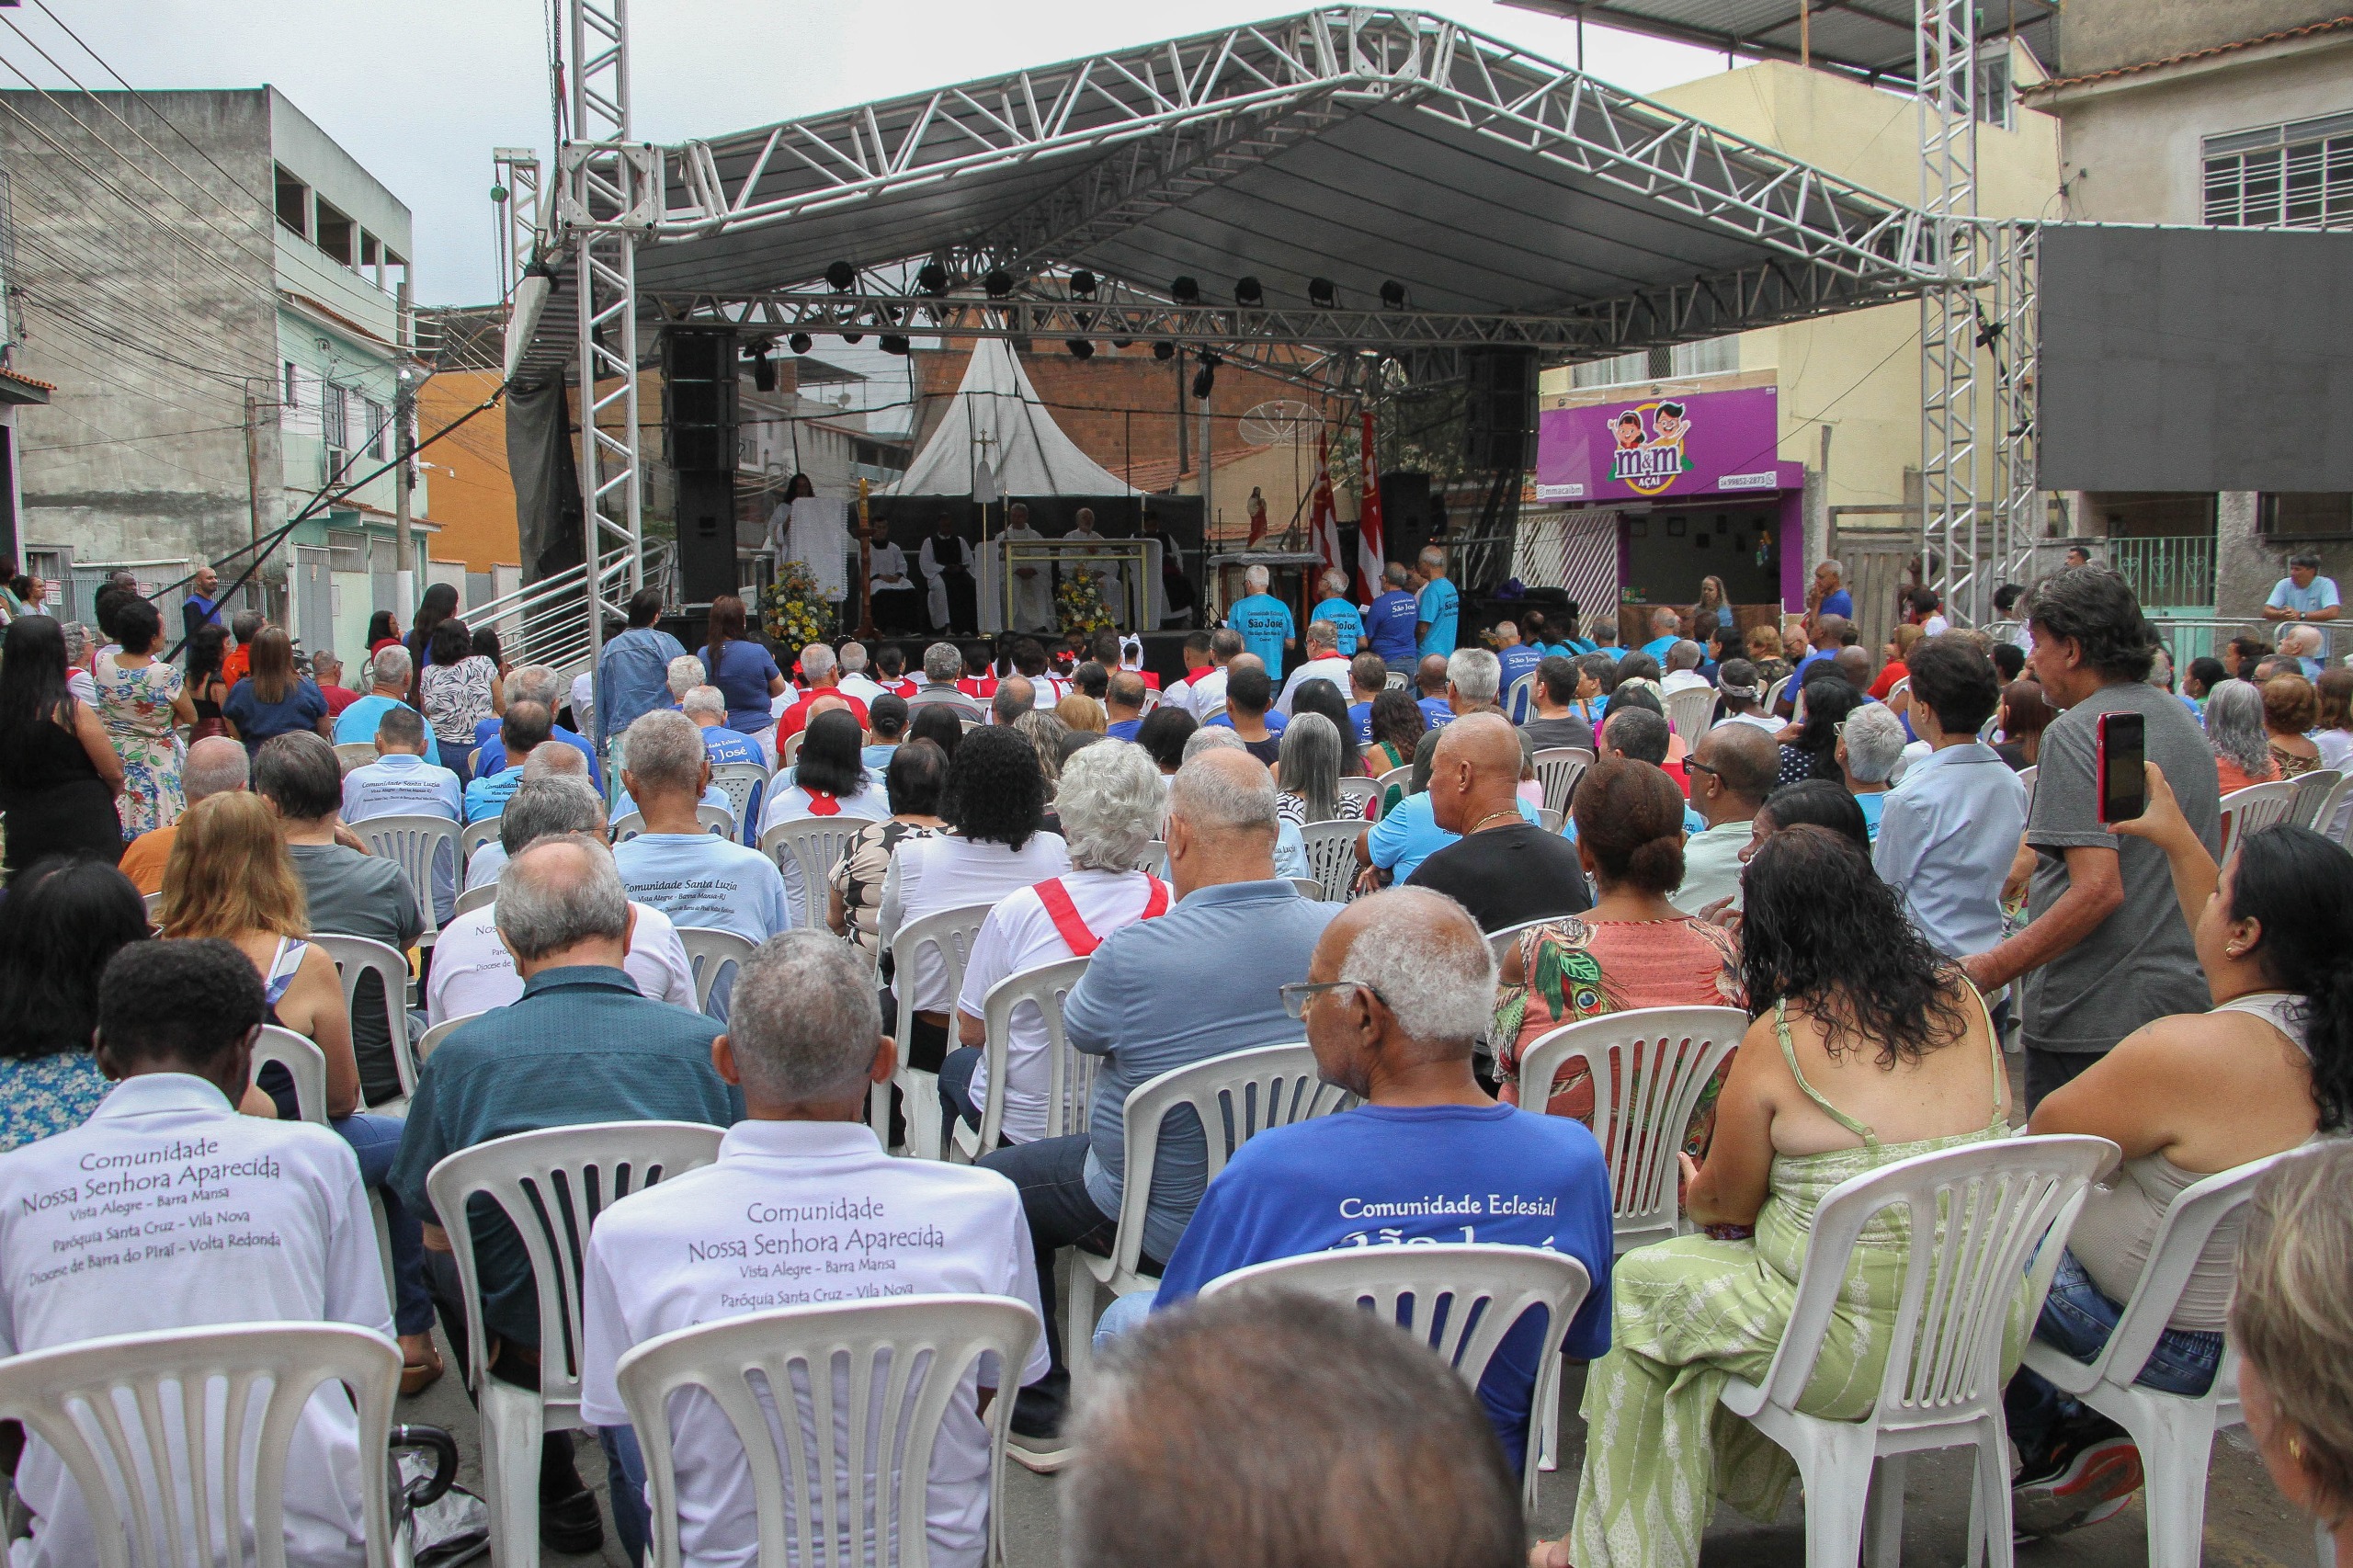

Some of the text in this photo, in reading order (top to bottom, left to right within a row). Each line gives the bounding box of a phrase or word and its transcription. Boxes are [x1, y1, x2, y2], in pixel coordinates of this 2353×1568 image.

[1638, 475, 1661, 488] AÇAÍ
[1247, 619, 1283, 628] São José
[718, 746, 748, 762] José
[624, 880, 738, 893] Comunidade Santa Luzia
[654, 894, 674, 903] Alegre
[475, 925, 497, 936] Nos
[476, 961, 501, 971] Diocese
[502, 960, 511, 968] de
[80, 1137, 218, 1171] Comunidade
[21, 1155, 280, 1216] Nossa Senhora Aparecida
[70, 1206, 97, 1221] Vista
[101, 1199, 142, 1215] Alegre
[157, 1194, 188, 1207] Barra
[191, 1187, 230, 1202] Mansa
[746, 1196, 884, 1223] Comunidade
[1339, 1193, 1558, 1219] Comunidade Eclesial
[52, 1233, 102, 1254] Paróquia
[106, 1223, 141, 1240] Santa
[144, 1221, 175, 1234] Cruz
[188, 1213, 212, 1228] Vila
[217, 1210, 251, 1224] Nova
[688, 1223, 945, 1263] Nossa Senhora Aparecida
[70, 1259, 85, 1274] de
[88, 1253, 119, 1269] Barra
[123, 1248, 141, 1263] do
[189, 1234, 224, 1254] Volta
[229, 1231, 281, 1247] Redonda
[739, 1264, 768, 1278] Vista
[772, 1261, 812, 1279] Alegre
[825, 1258, 855, 1274] Barra
[858, 1256, 896, 1272] Mansa
[721, 1290, 774, 1311] Paróquia
[777, 1288, 810, 1303] Santa
[813, 1286, 842, 1301] Cruz
[856, 1282, 880, 1299] Vila
[884, 1282, 914, 1297] Nova
